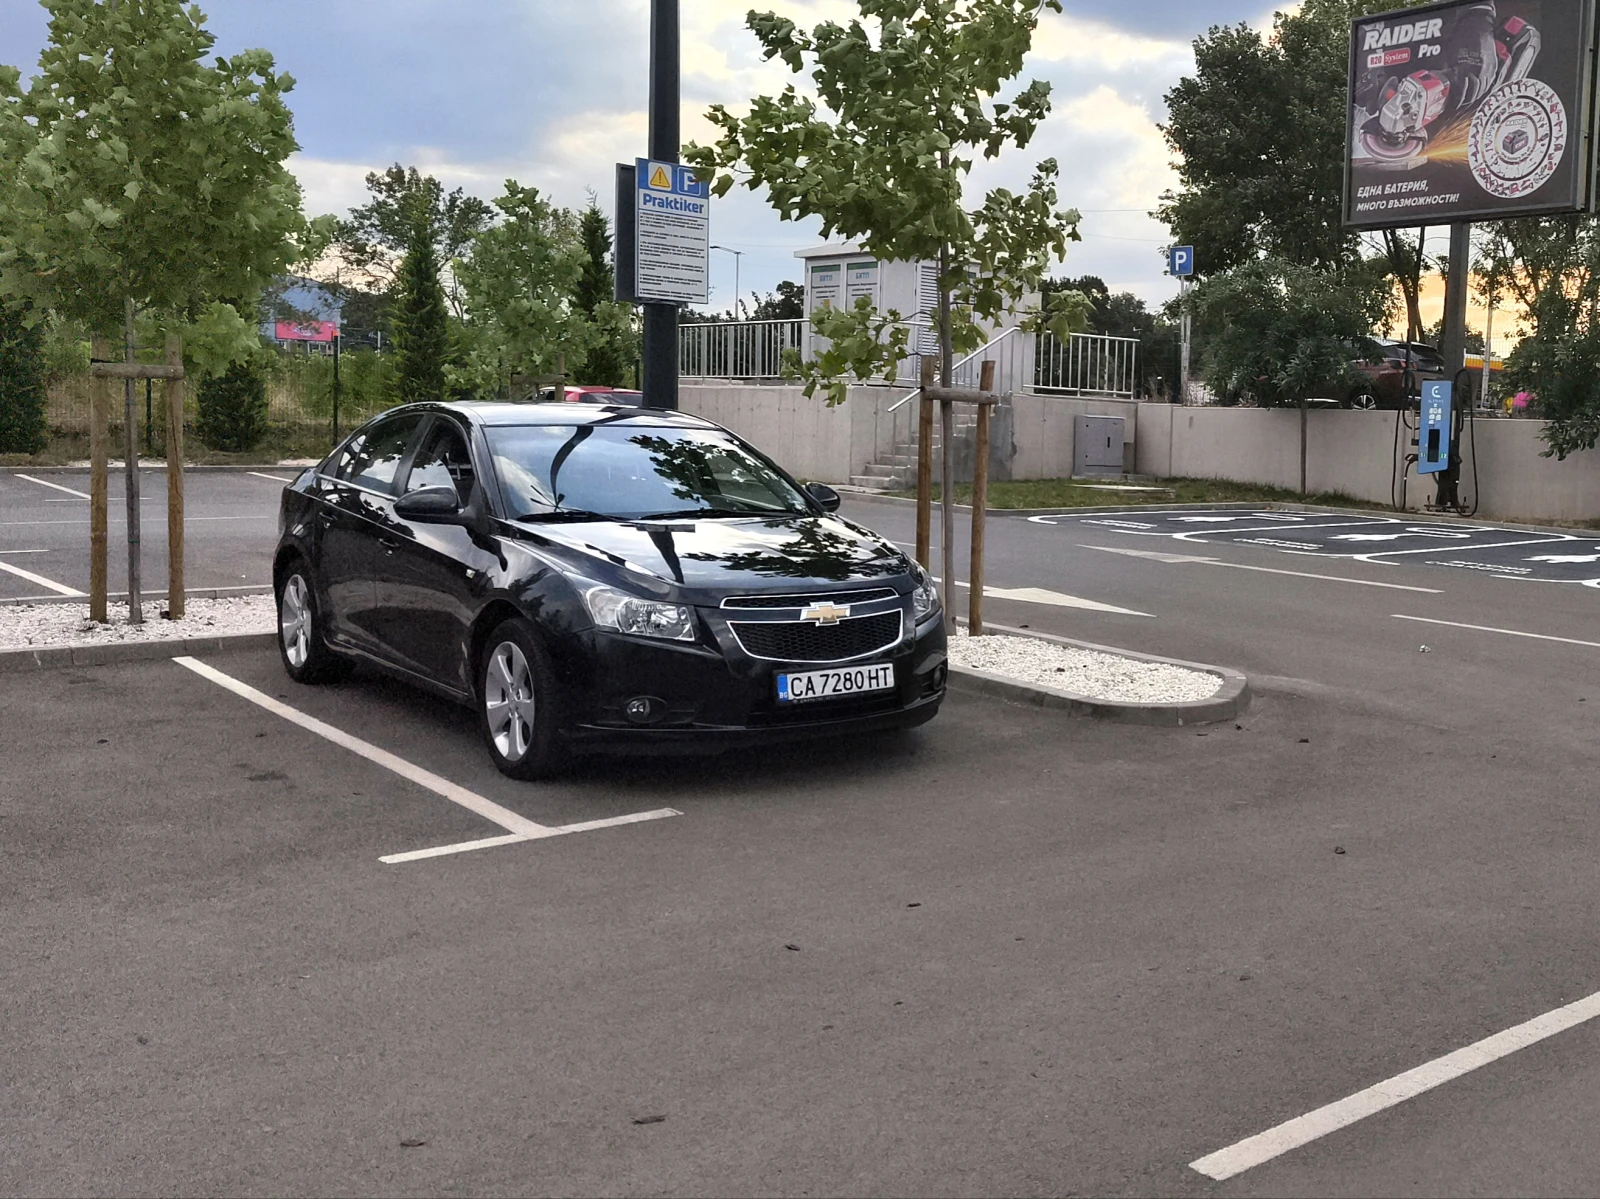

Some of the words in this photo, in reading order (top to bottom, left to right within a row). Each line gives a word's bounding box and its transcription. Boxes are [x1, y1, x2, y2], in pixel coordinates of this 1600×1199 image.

[1363, 18, 1443, 51] RAIDER
[1370, 55, 1382, 66] R20
[1385, 52, 1409, 63] System
[1418, 44, 1441, 58] Pro
[684, 172, 697, 191] P
[1357, 185, 1382, 198] ЕДНА
[1384, 180, 1429, 195] БАТЕРИЯ,
[643, 193, 705, 214] Praktiker
[1356, 200, 1387, 212] МНОГО
[1387, 193, 1460, 209] ВЪЗМОЖНОСТИ!
[1175, 251, 1187, 271] P
